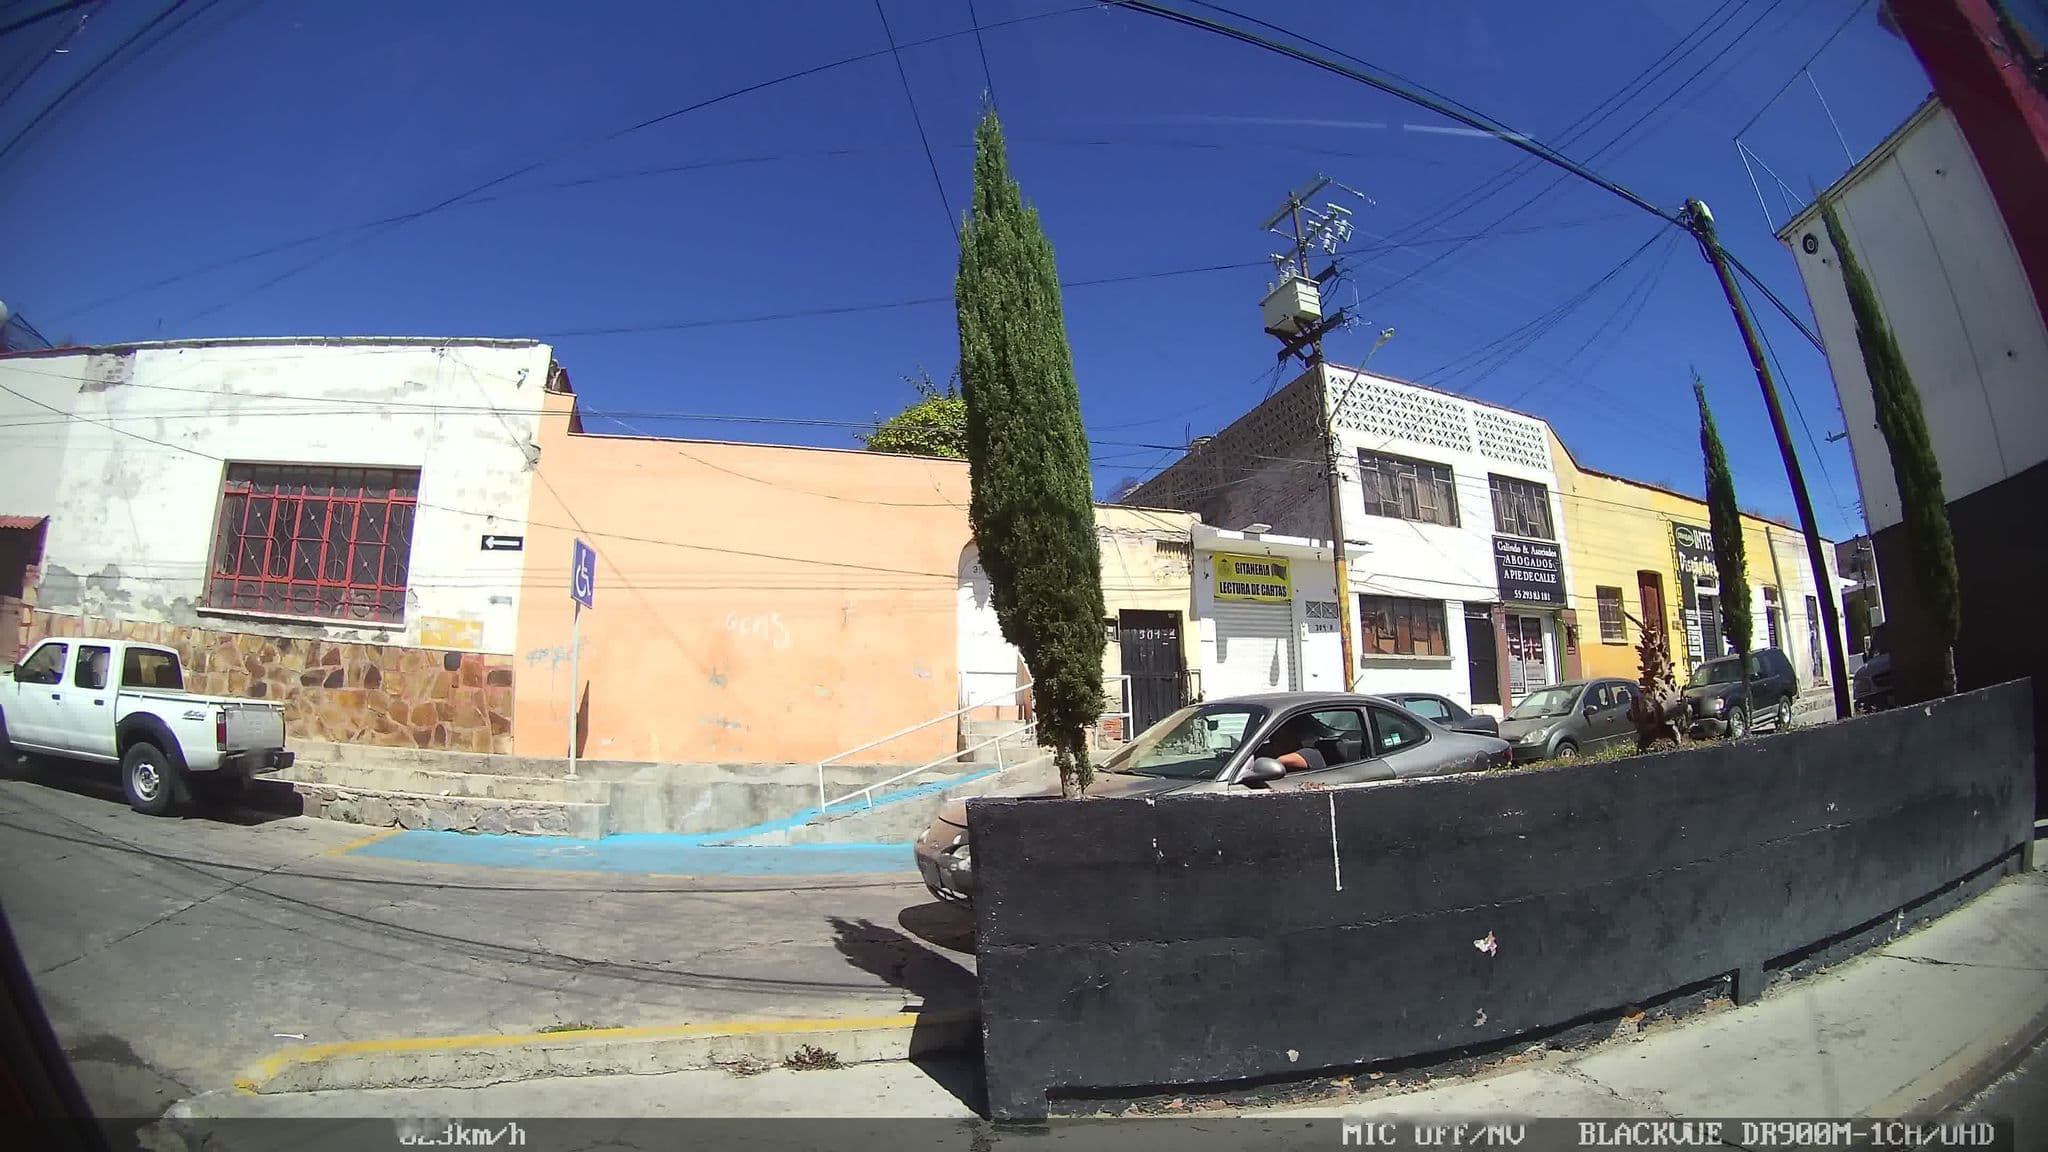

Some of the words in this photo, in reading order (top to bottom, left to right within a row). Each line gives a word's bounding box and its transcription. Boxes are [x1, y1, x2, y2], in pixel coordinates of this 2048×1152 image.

[1522, 545, 1530, 554] &
[1505, 554, 1553, 569] ABOGADOS
[1523, 571, 1534, 582] DE
[1534, 572, 1557, 584] CALLE
[1220, 581, 1250, 596] LECTURA
[1251, 583, 1260, 596] DE
[1261, 584, 1287, 597] CARTAS
